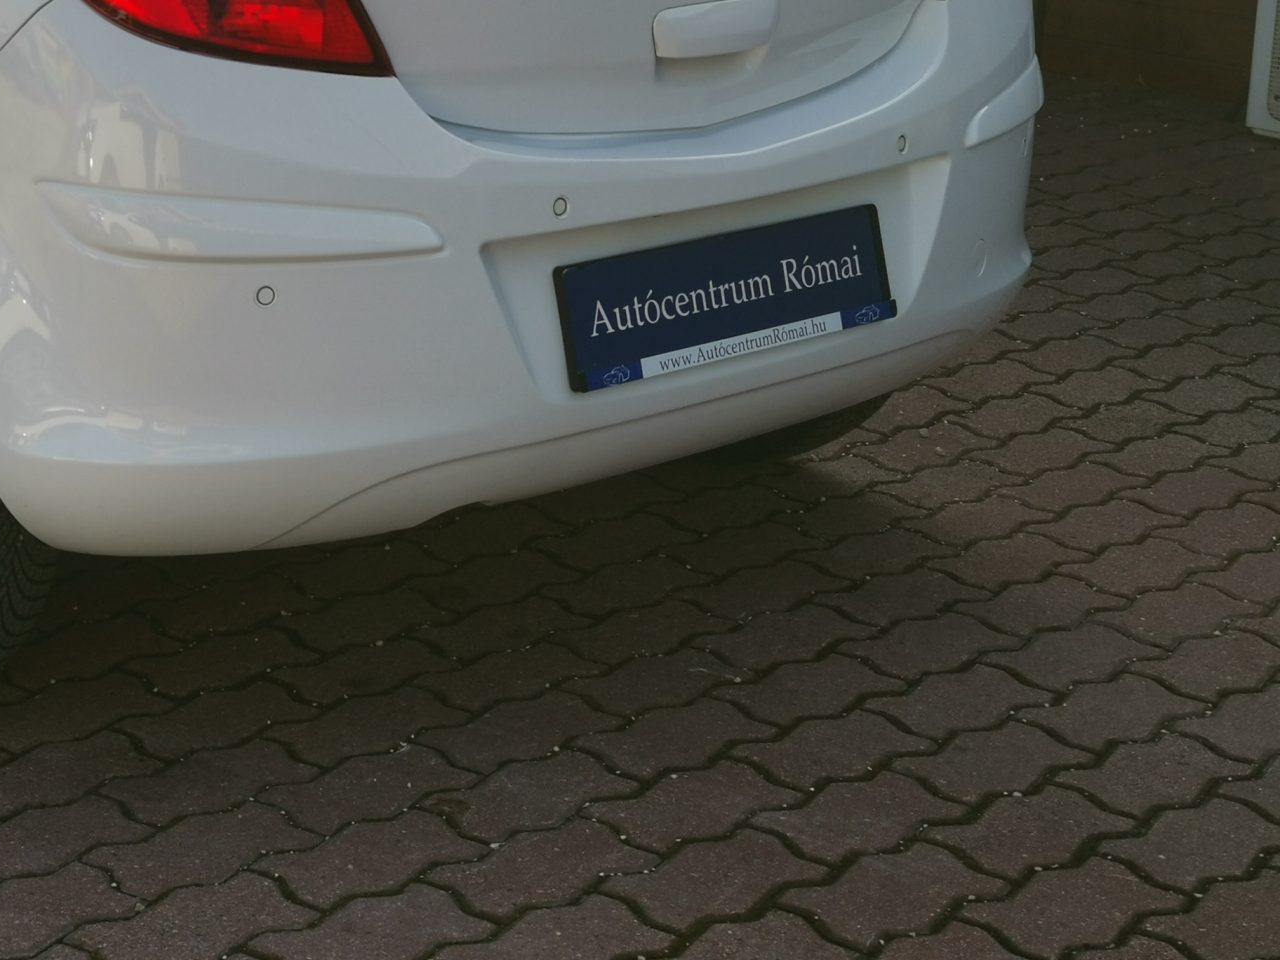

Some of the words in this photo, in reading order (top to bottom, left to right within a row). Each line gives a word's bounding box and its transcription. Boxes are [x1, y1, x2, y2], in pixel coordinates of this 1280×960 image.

[590, 272, 774, 338] Autócentrum
[780, 245, 863, 294] Római
[659, 319, 827, 372] www.AutócentrumRómai.hu
